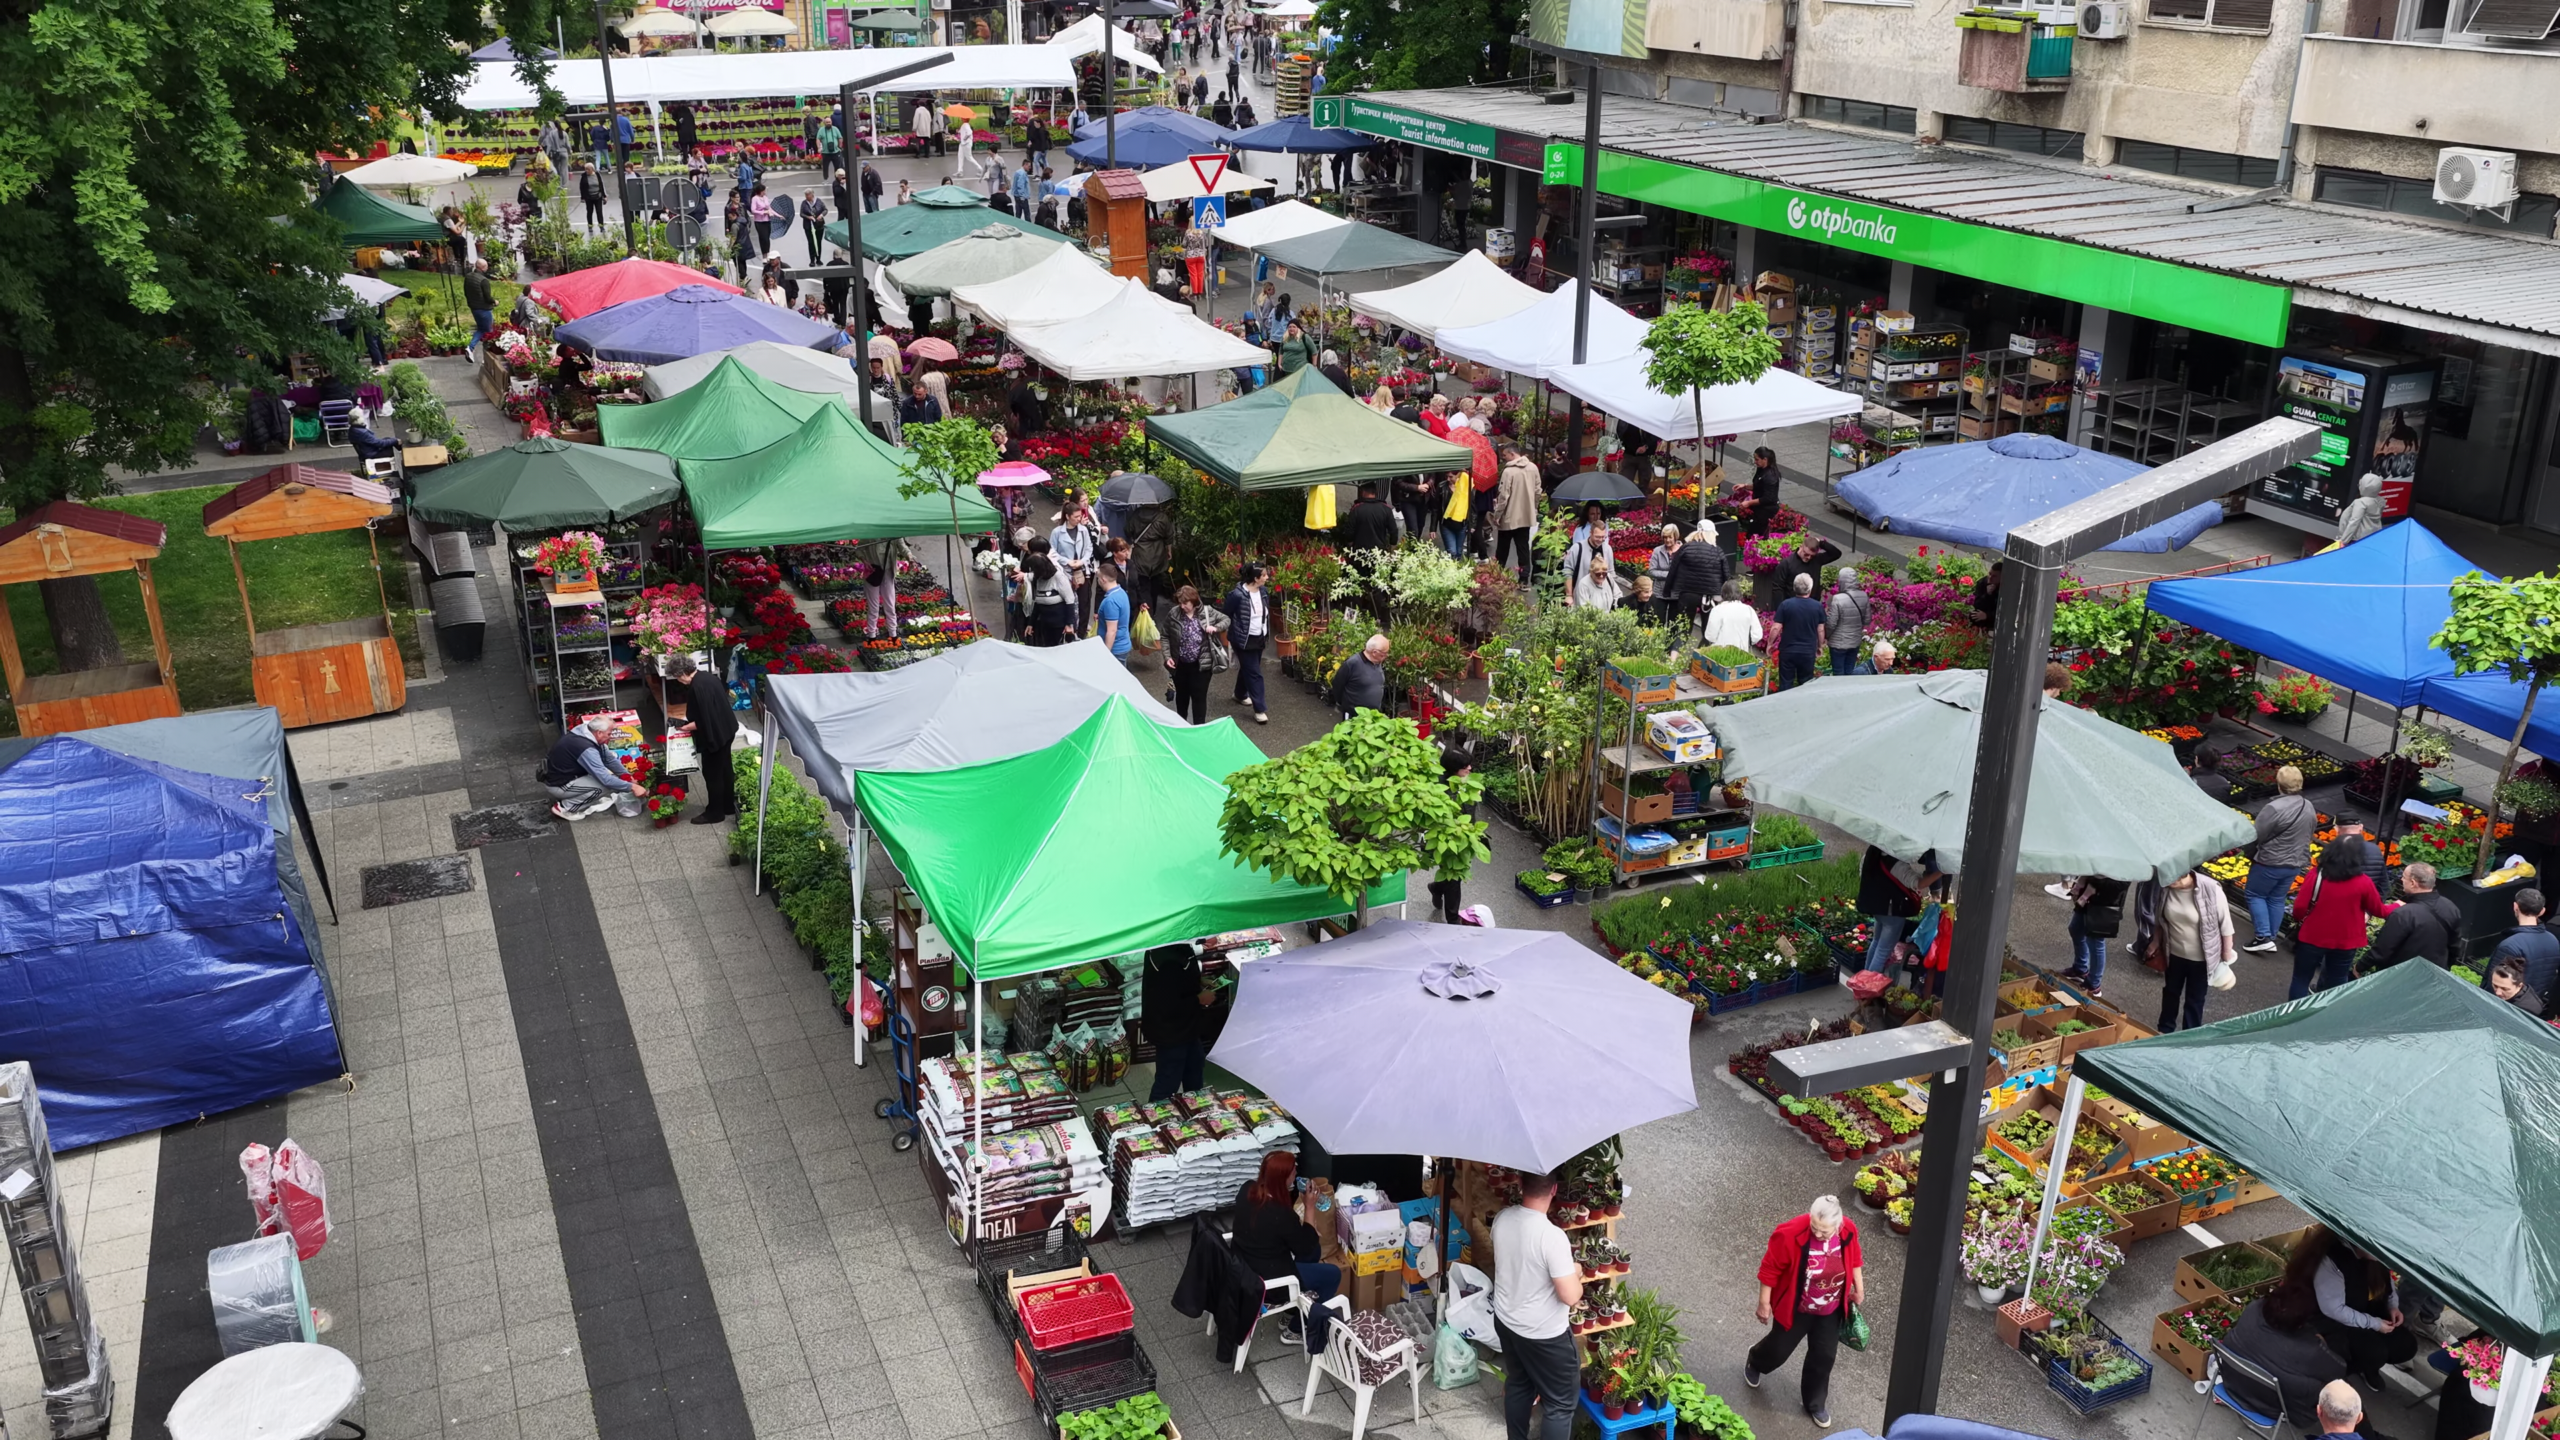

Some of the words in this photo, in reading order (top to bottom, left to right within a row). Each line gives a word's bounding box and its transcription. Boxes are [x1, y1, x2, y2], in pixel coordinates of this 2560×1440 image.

[1351, 102, 1381, 119] Туристички
[1382, 112, 1424, 128] информативни
[1425, 119, 1447, 134] центар
[1400, 125, 1423, 141] Tourist
[1424, 130, 1465, 150] information
[1466, 142, 1490, 155] center
[1549, 170, 1565, 179] 0-24
[1810, 206, 1897, 245] otpbanka
[2292, 405, 2317, 420] GUMA
[2317, 411, 2347, 428] CENTAR
[919, 955, 950, 965] Plantella
[1054, 1121, 1073, 1151] antella
[2197, 1207, 2215, 1219] toco
